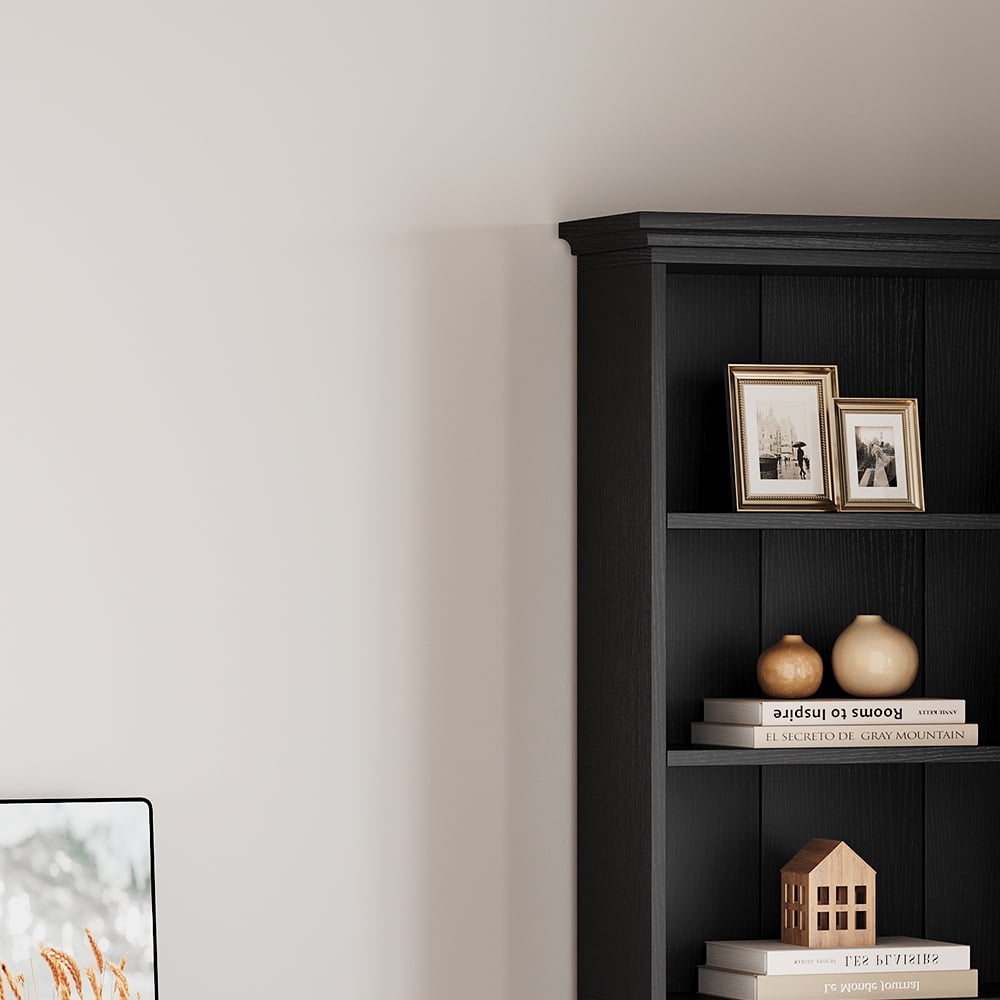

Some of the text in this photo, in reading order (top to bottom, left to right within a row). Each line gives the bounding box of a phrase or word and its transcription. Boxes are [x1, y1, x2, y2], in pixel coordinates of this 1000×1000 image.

[773, 705, 825, 721] Inspire
[831, 708, 847, 720] to
[852, 708, 903, 720] Rooms
[766, 730, 965, 741] EL SECRETO DE GRAY MOUNTAIN
